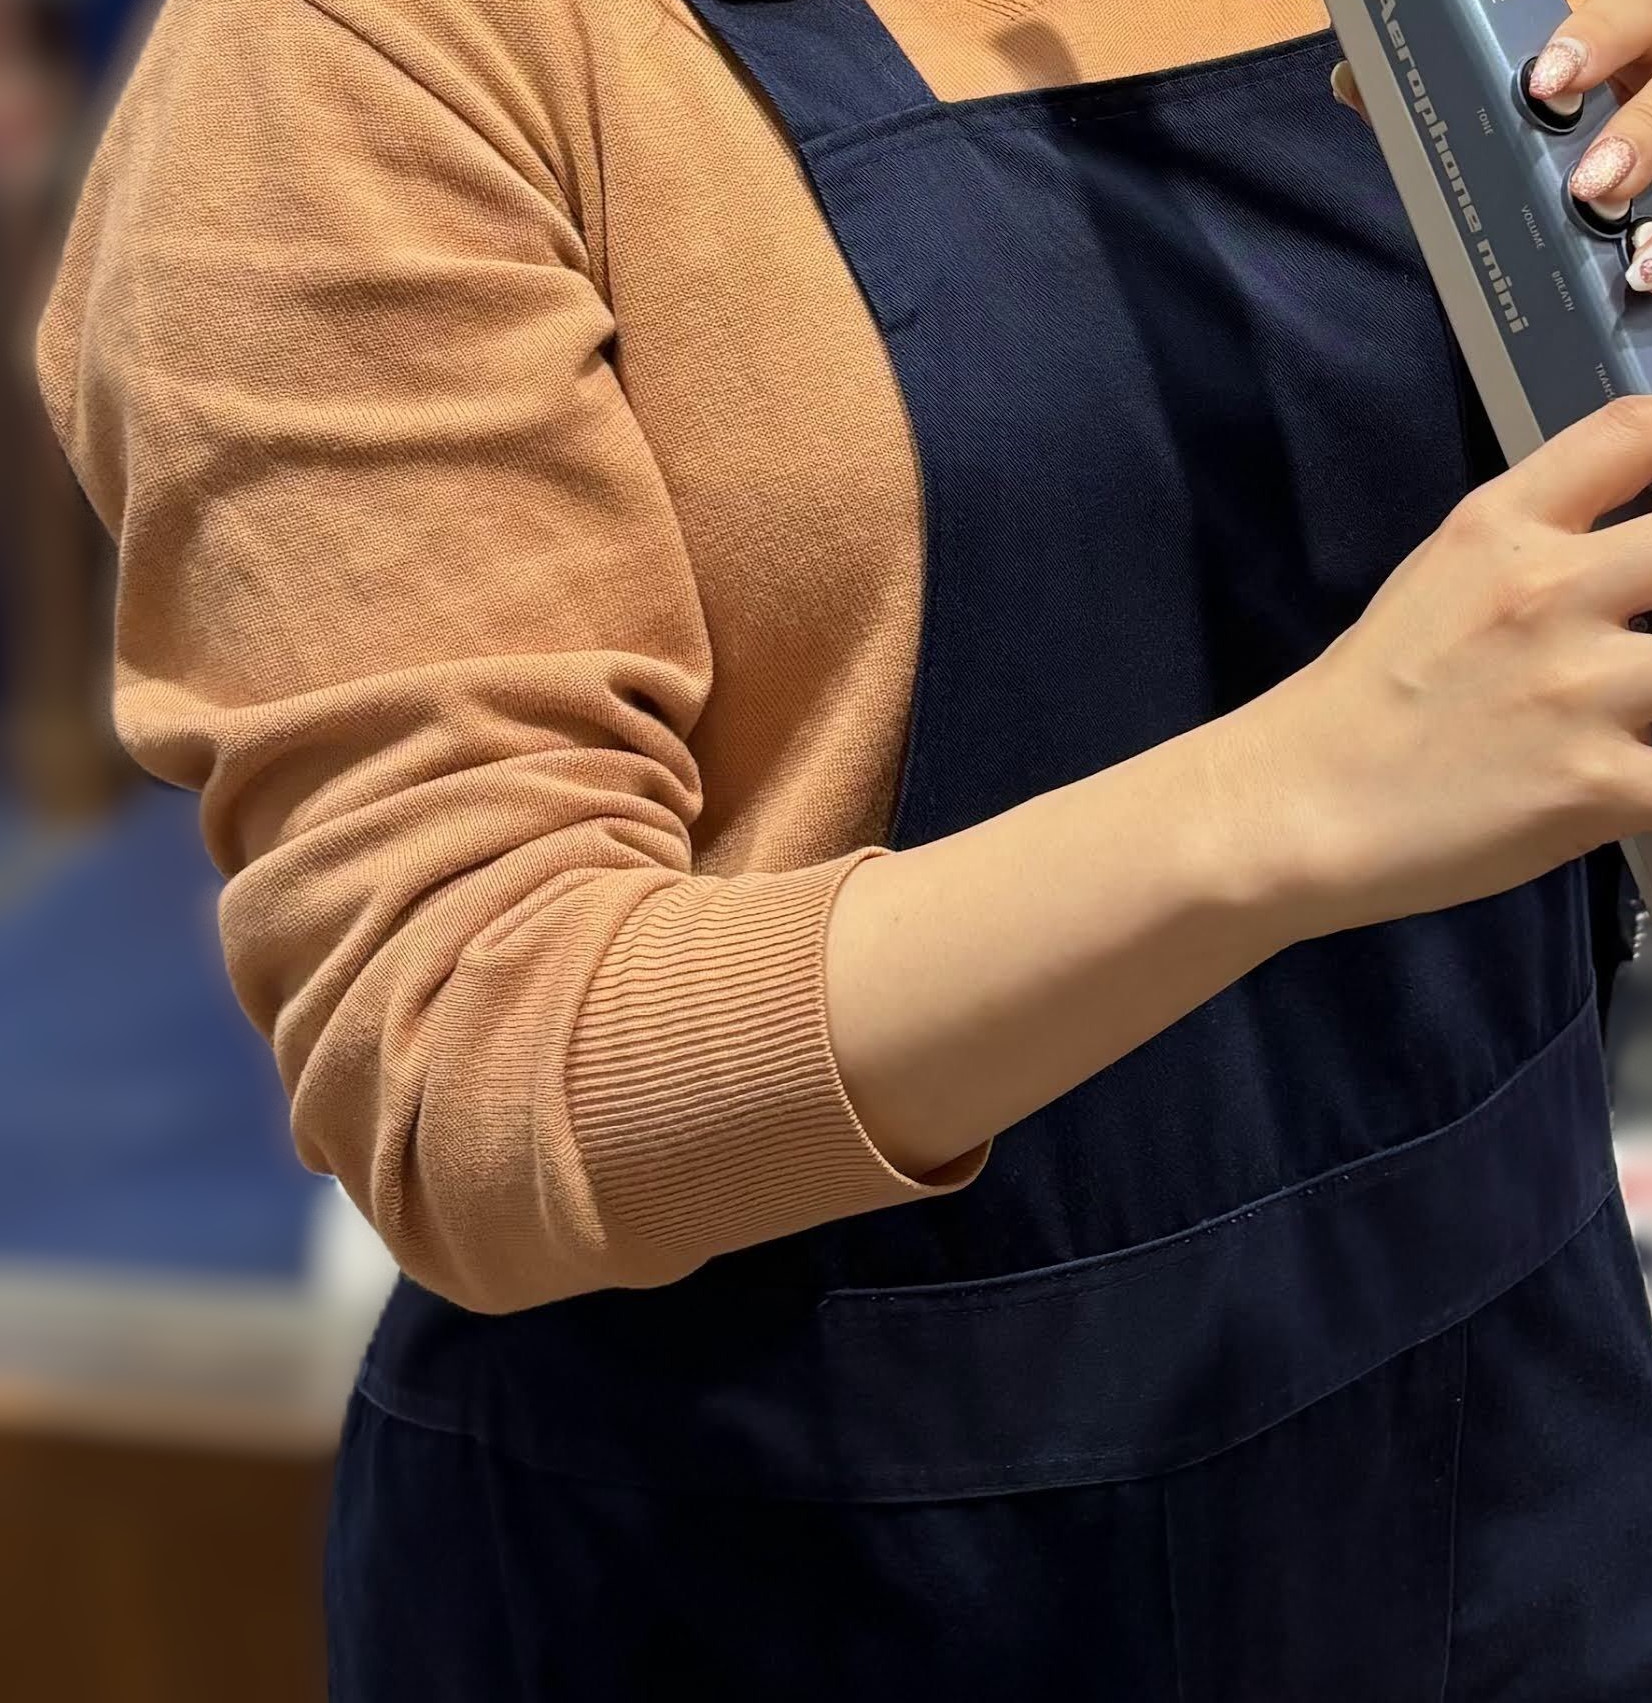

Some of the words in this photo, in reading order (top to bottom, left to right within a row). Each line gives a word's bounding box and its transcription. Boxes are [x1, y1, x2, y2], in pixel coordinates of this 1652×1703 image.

[1476, 107, 1495, 137] TONE
[1520, 203, 1546, 250] VOLUME
[1476, 238, 1530, 334] mini
[1551, 269, 1576, 313] BREATH
[1595, 361, 1617, 400] TRANS
